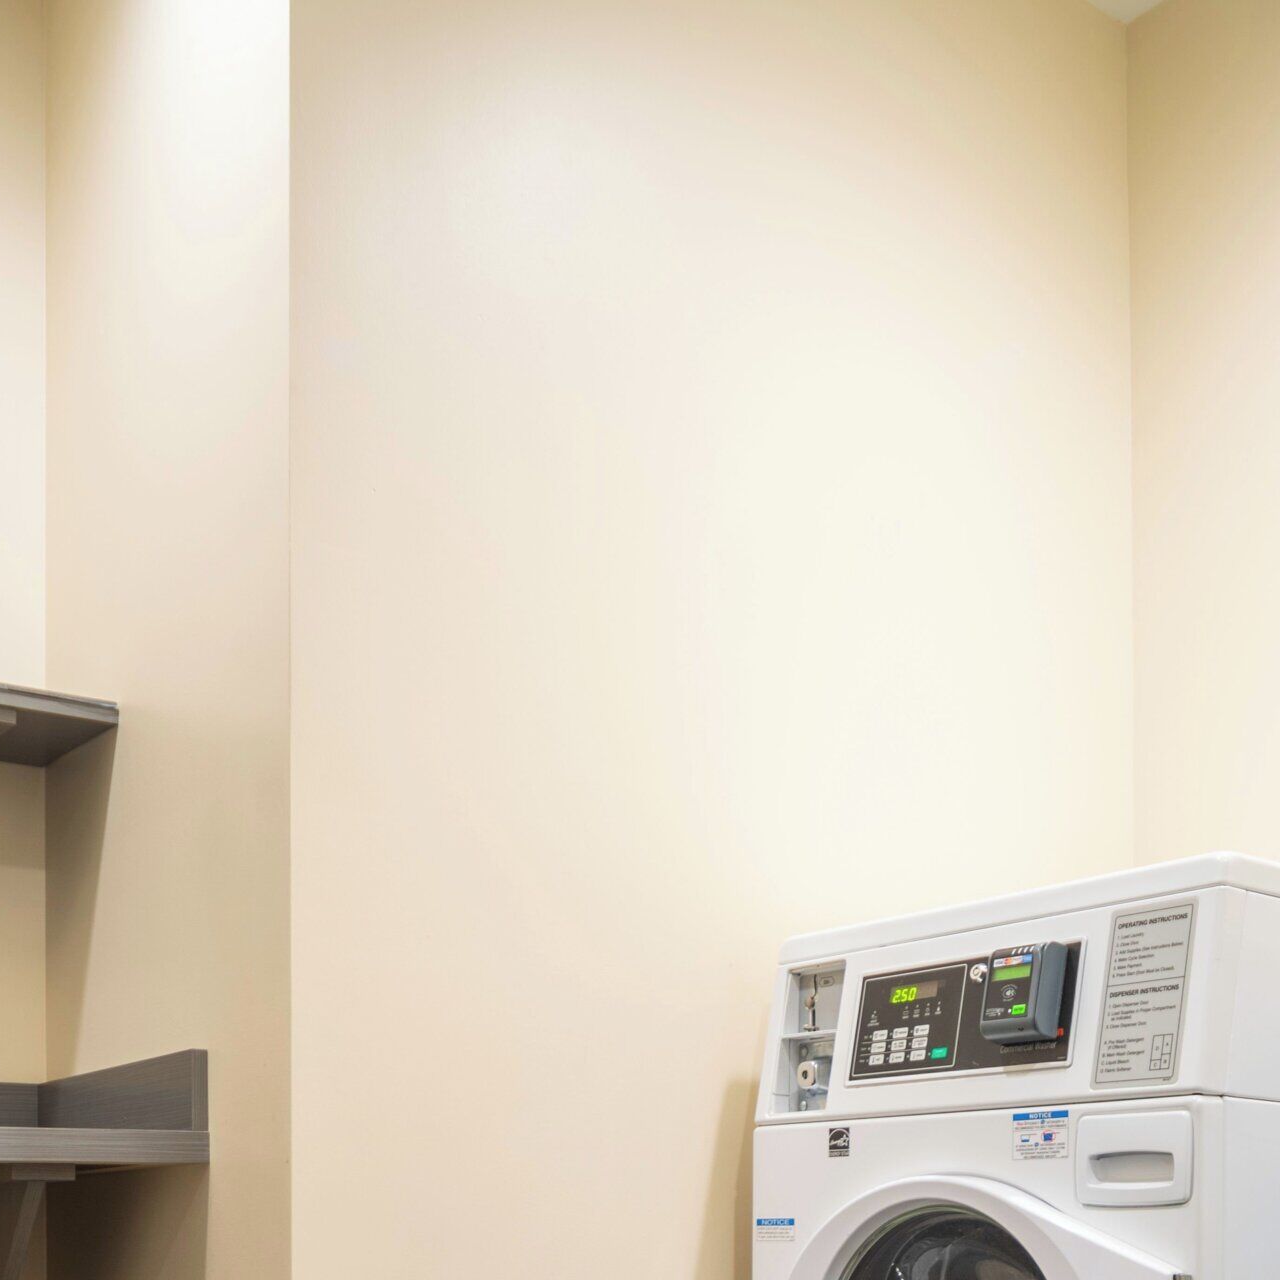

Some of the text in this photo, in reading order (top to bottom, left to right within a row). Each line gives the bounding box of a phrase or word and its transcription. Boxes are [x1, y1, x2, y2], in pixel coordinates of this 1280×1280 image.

[1117, 912, 1189, 930] OPERATING INSTRUCTIONS
[891, 986, 917, 1004] 2.50
[1109, 983, 1179, 999] DISPENSER INSTRUCTIONS
